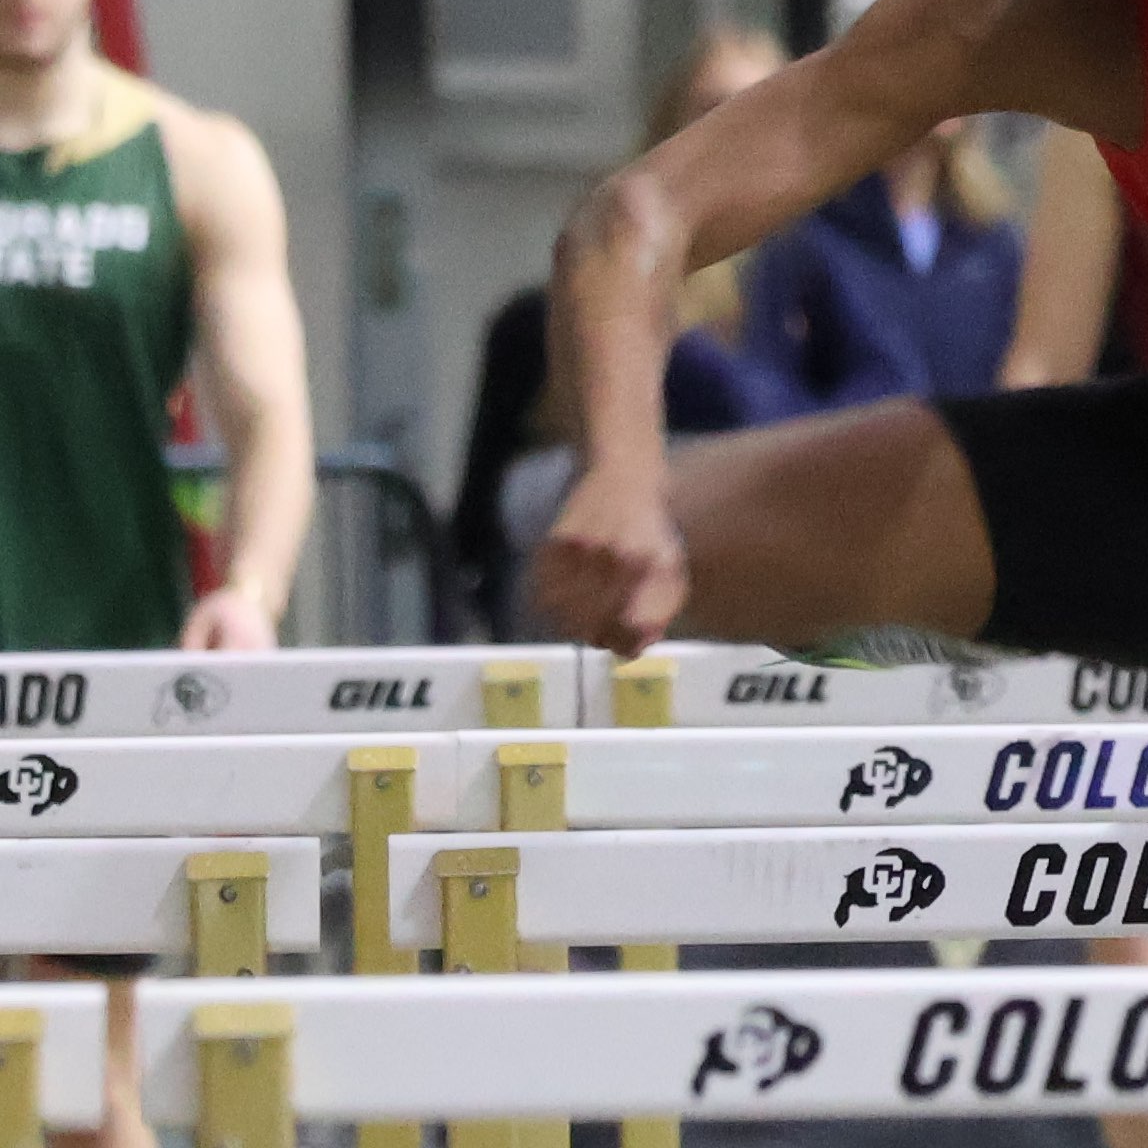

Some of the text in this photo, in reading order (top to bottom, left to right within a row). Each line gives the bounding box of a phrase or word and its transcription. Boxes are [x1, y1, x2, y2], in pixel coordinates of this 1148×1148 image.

[0, 672, 88, 728] DO
[328, 678, 432, 710] GILL
[724, 673, 828, 705] GILL
